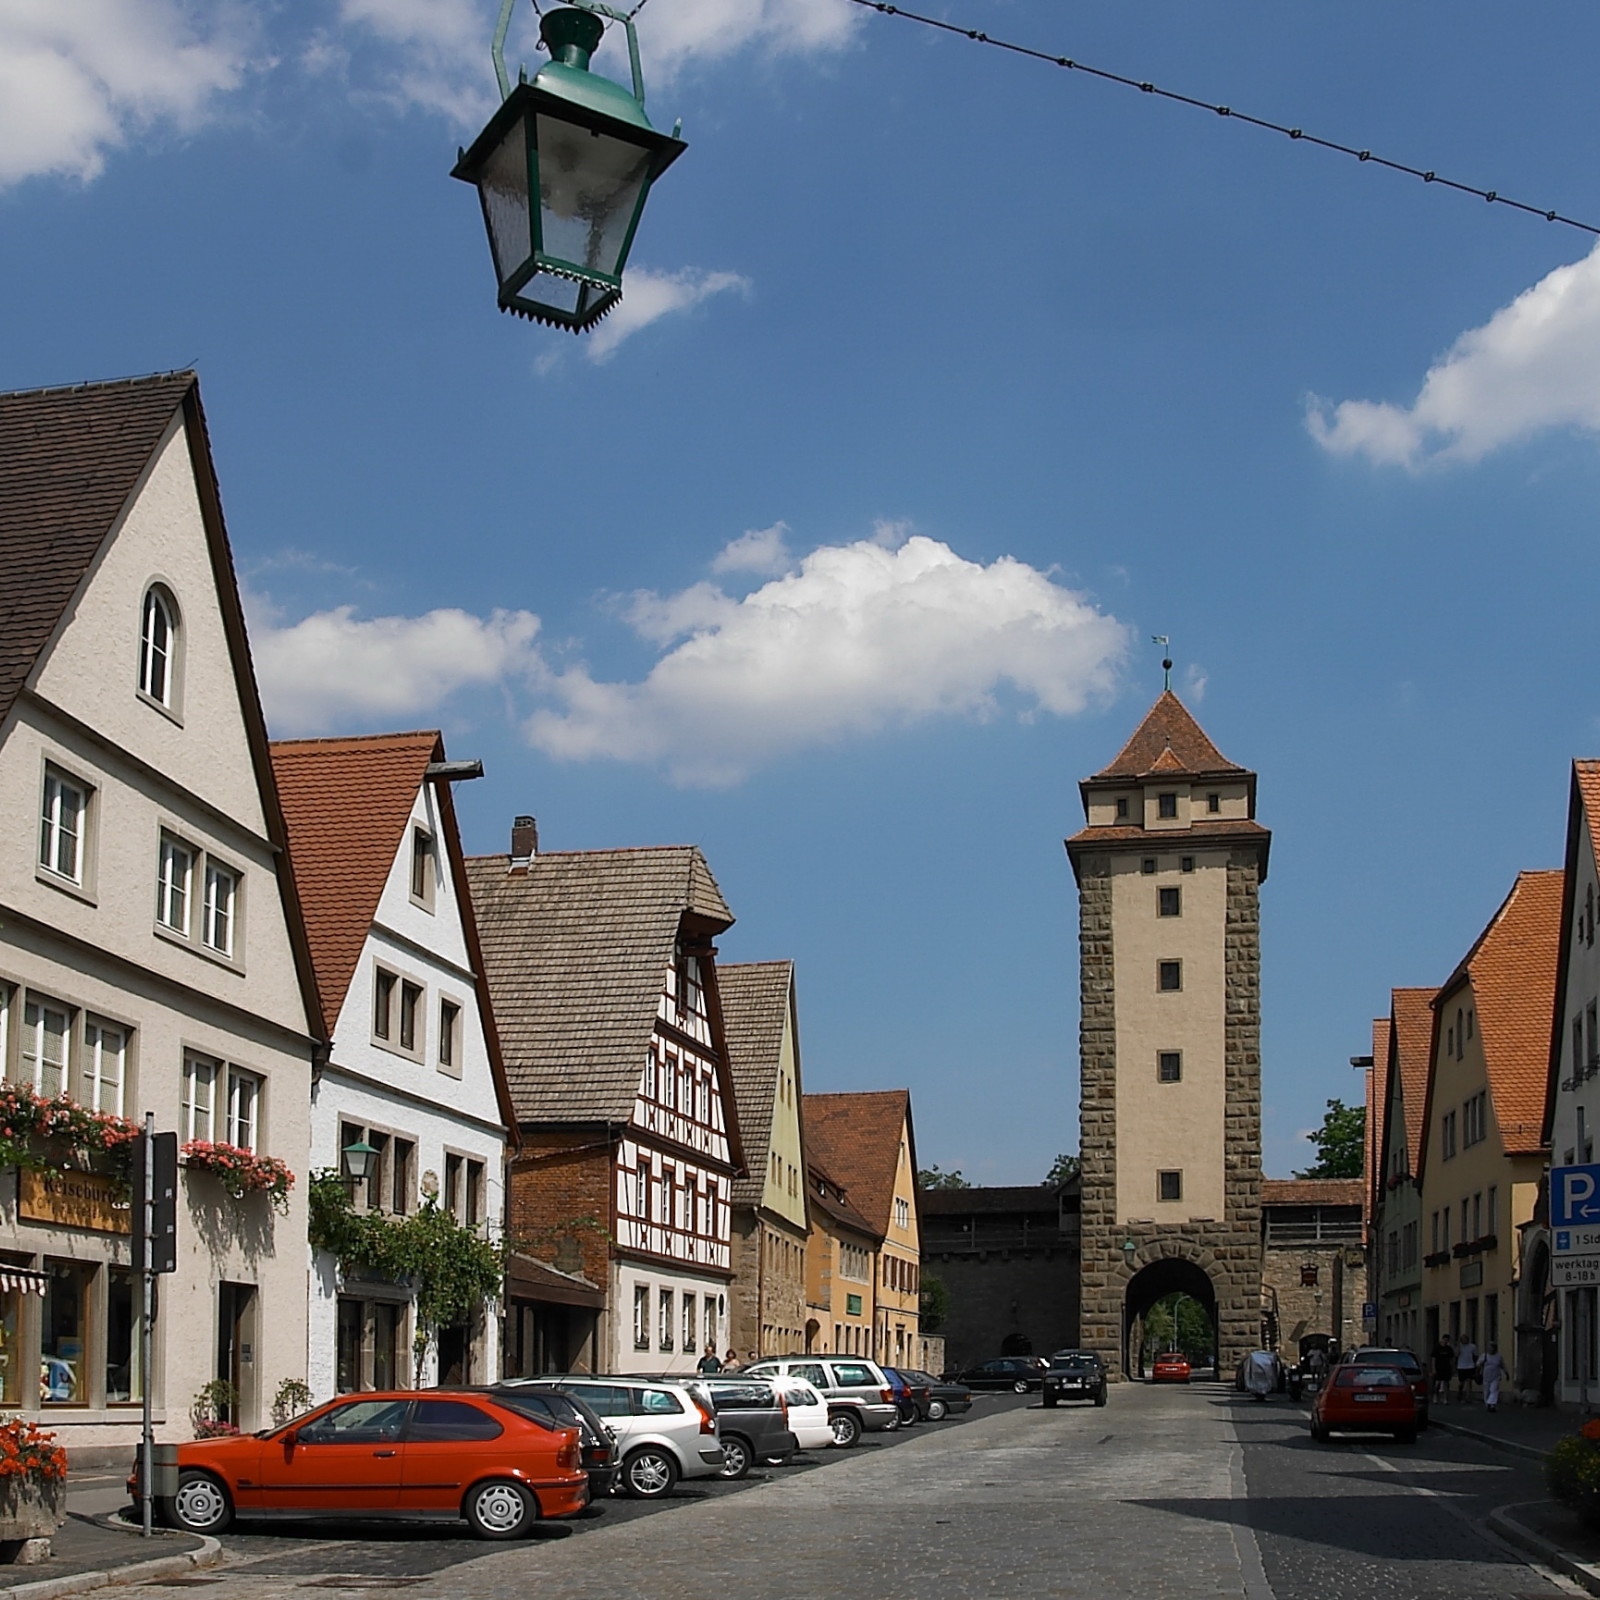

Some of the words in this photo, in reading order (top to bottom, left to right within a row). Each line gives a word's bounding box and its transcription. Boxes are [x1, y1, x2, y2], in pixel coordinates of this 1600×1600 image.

[1564, 1173, 1595, 1219] P
[1576, 1235, 1580, 1245] 1
[1555, 1259, 1599, 1270] werktag
[1565, 1271, 1588, 1281] 8-18
[1590, 1271, 1596, 1280] h
[1365, 1304, 1373, 1316] P
